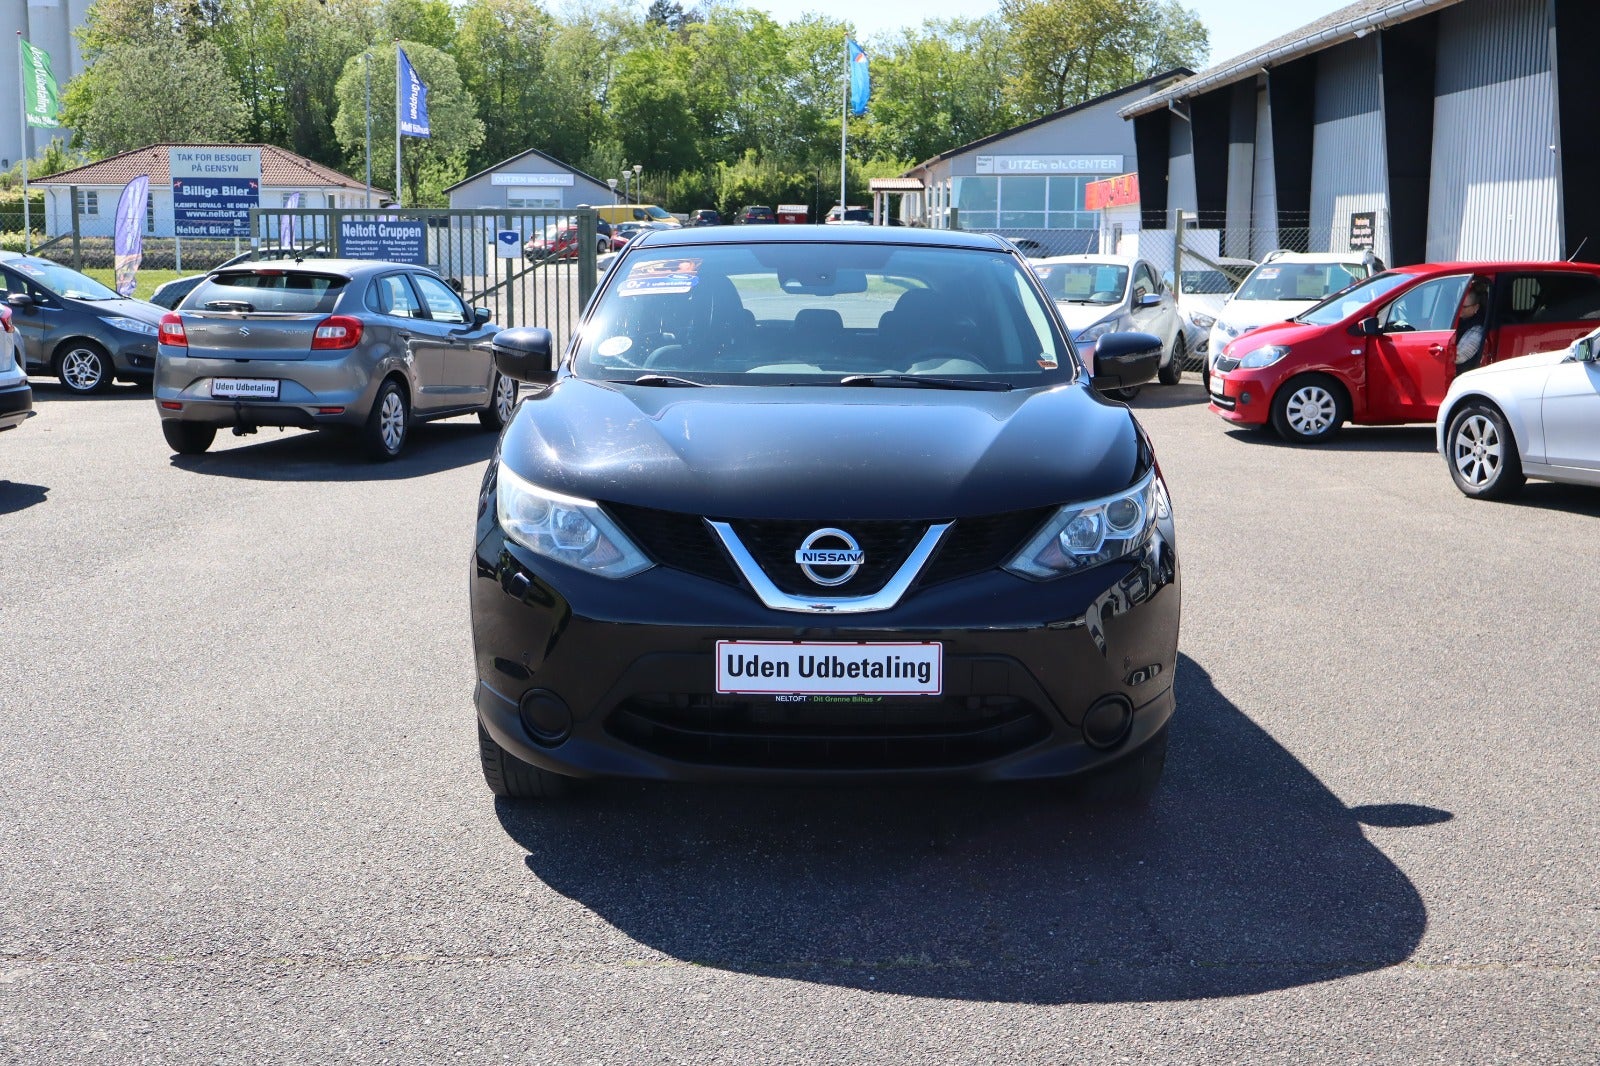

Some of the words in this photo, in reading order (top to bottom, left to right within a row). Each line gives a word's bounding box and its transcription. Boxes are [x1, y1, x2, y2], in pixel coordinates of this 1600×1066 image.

[177, 153, 193, 161] TAK
[214, 154, 253, 162] BESØGET
[191, 164, 203, 172] PÅ
[205, 165, 239, 173] GENSYN
[182, 185, 219, 198] Billige
[222, 186, 250, 196] Biler
[186, 210, 248, 218] www.neltoft.dk
[176, 226, 207, 234] Neltoft
[209, 226, 231, 234] Biler
[342, 223, 377, 237] Neltoft
[378, 224, 422, 240] Gruppen
[215, 383, 234, 391] Uden
[236, 383, 276, 393] Udbetaling
[802, 552, 858, 562] NISSAN
[727, 654, 790, 678] Uden
[798, 655, 931, 684] Udbetaling
